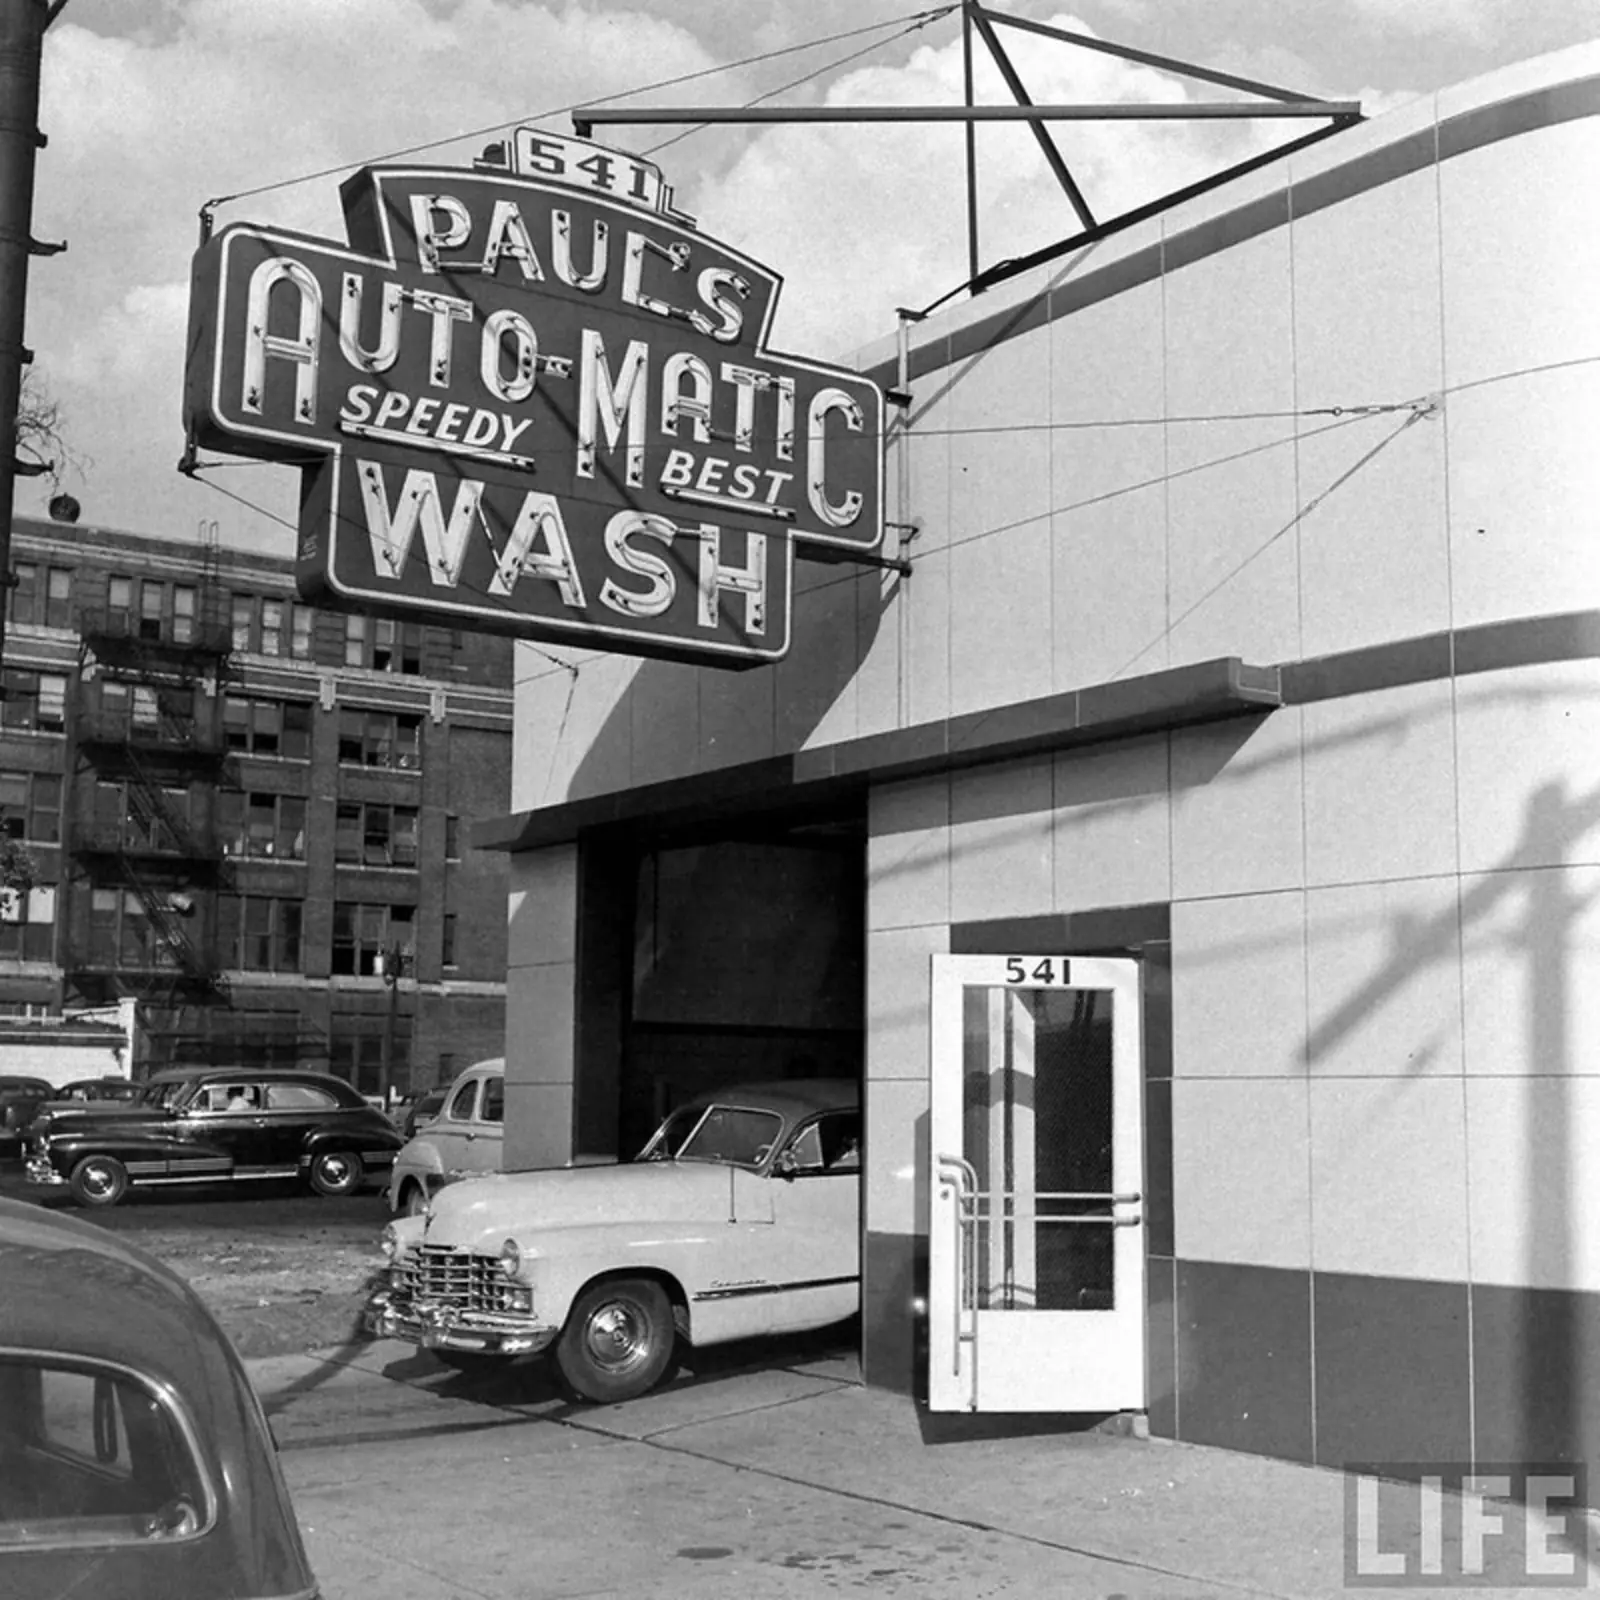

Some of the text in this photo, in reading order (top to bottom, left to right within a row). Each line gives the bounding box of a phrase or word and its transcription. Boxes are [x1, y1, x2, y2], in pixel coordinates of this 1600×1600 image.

[530, 138, 649, 201] 541
[409, 194, 751, 342] PAUL'S
[339, 384, 533, 451] SPEEDY
[660, 449, 793, 504] BEST
[356, 458, 767, 635] WASH
[1006, 957, 1070, 985] 541
